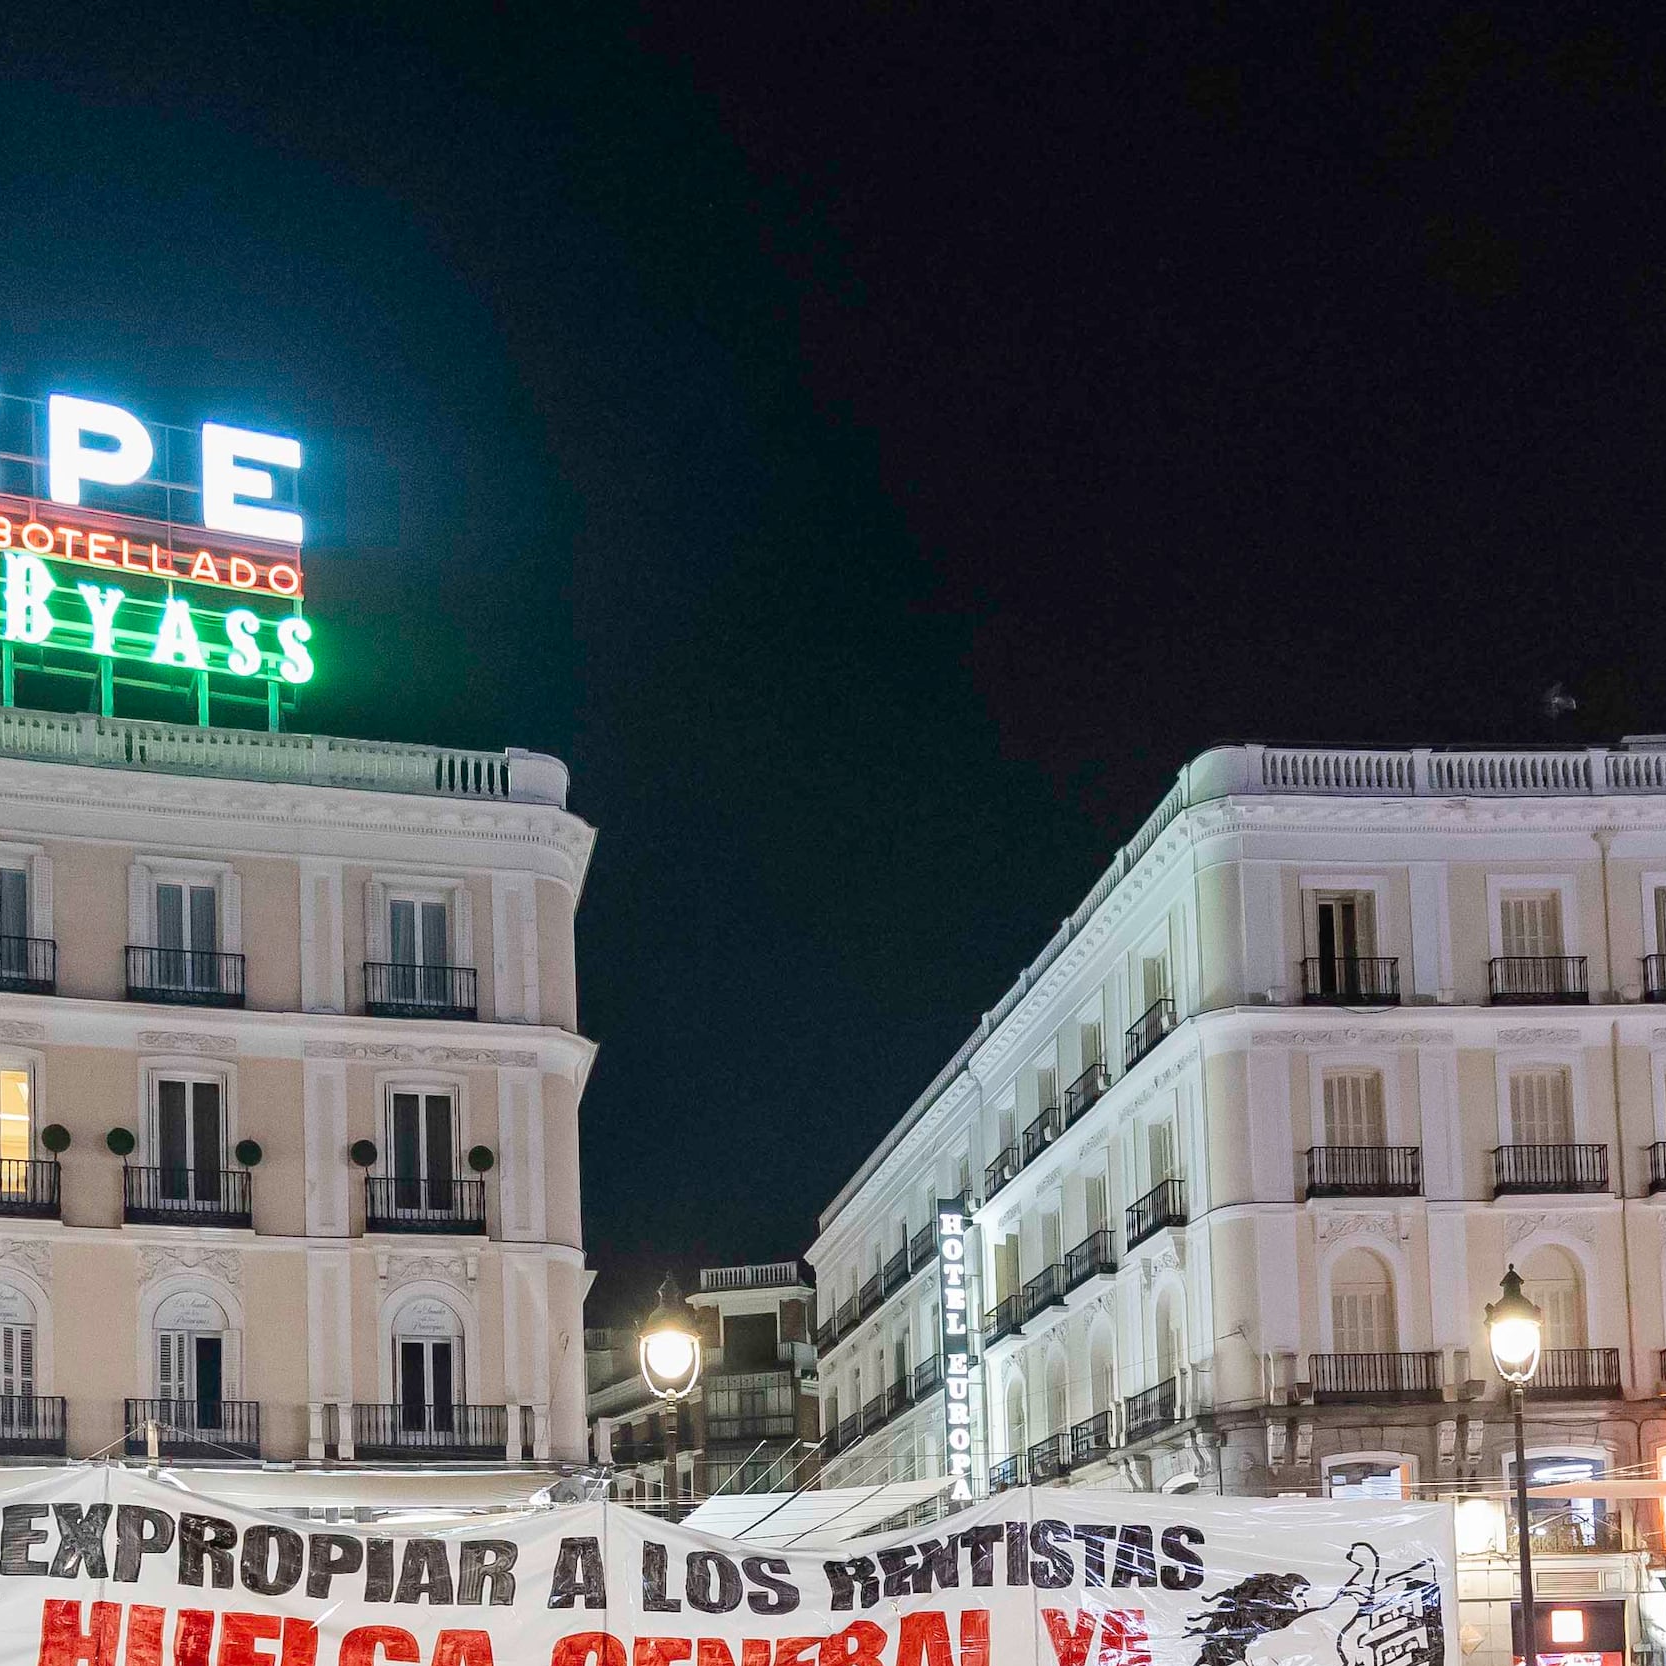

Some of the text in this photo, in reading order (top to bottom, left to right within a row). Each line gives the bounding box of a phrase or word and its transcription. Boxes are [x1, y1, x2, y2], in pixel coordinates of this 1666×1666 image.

[3, 551, 315, 684] BYASS
[939, 1213, 968, 1335] HOTEL
[946, 1353, 972, 1500] EUROPA
[548, 1537, 607, 1610] A
[641, 1540, 801, 1614] LOS
[823, 1518, 1205, 1611] RENTISTAS
